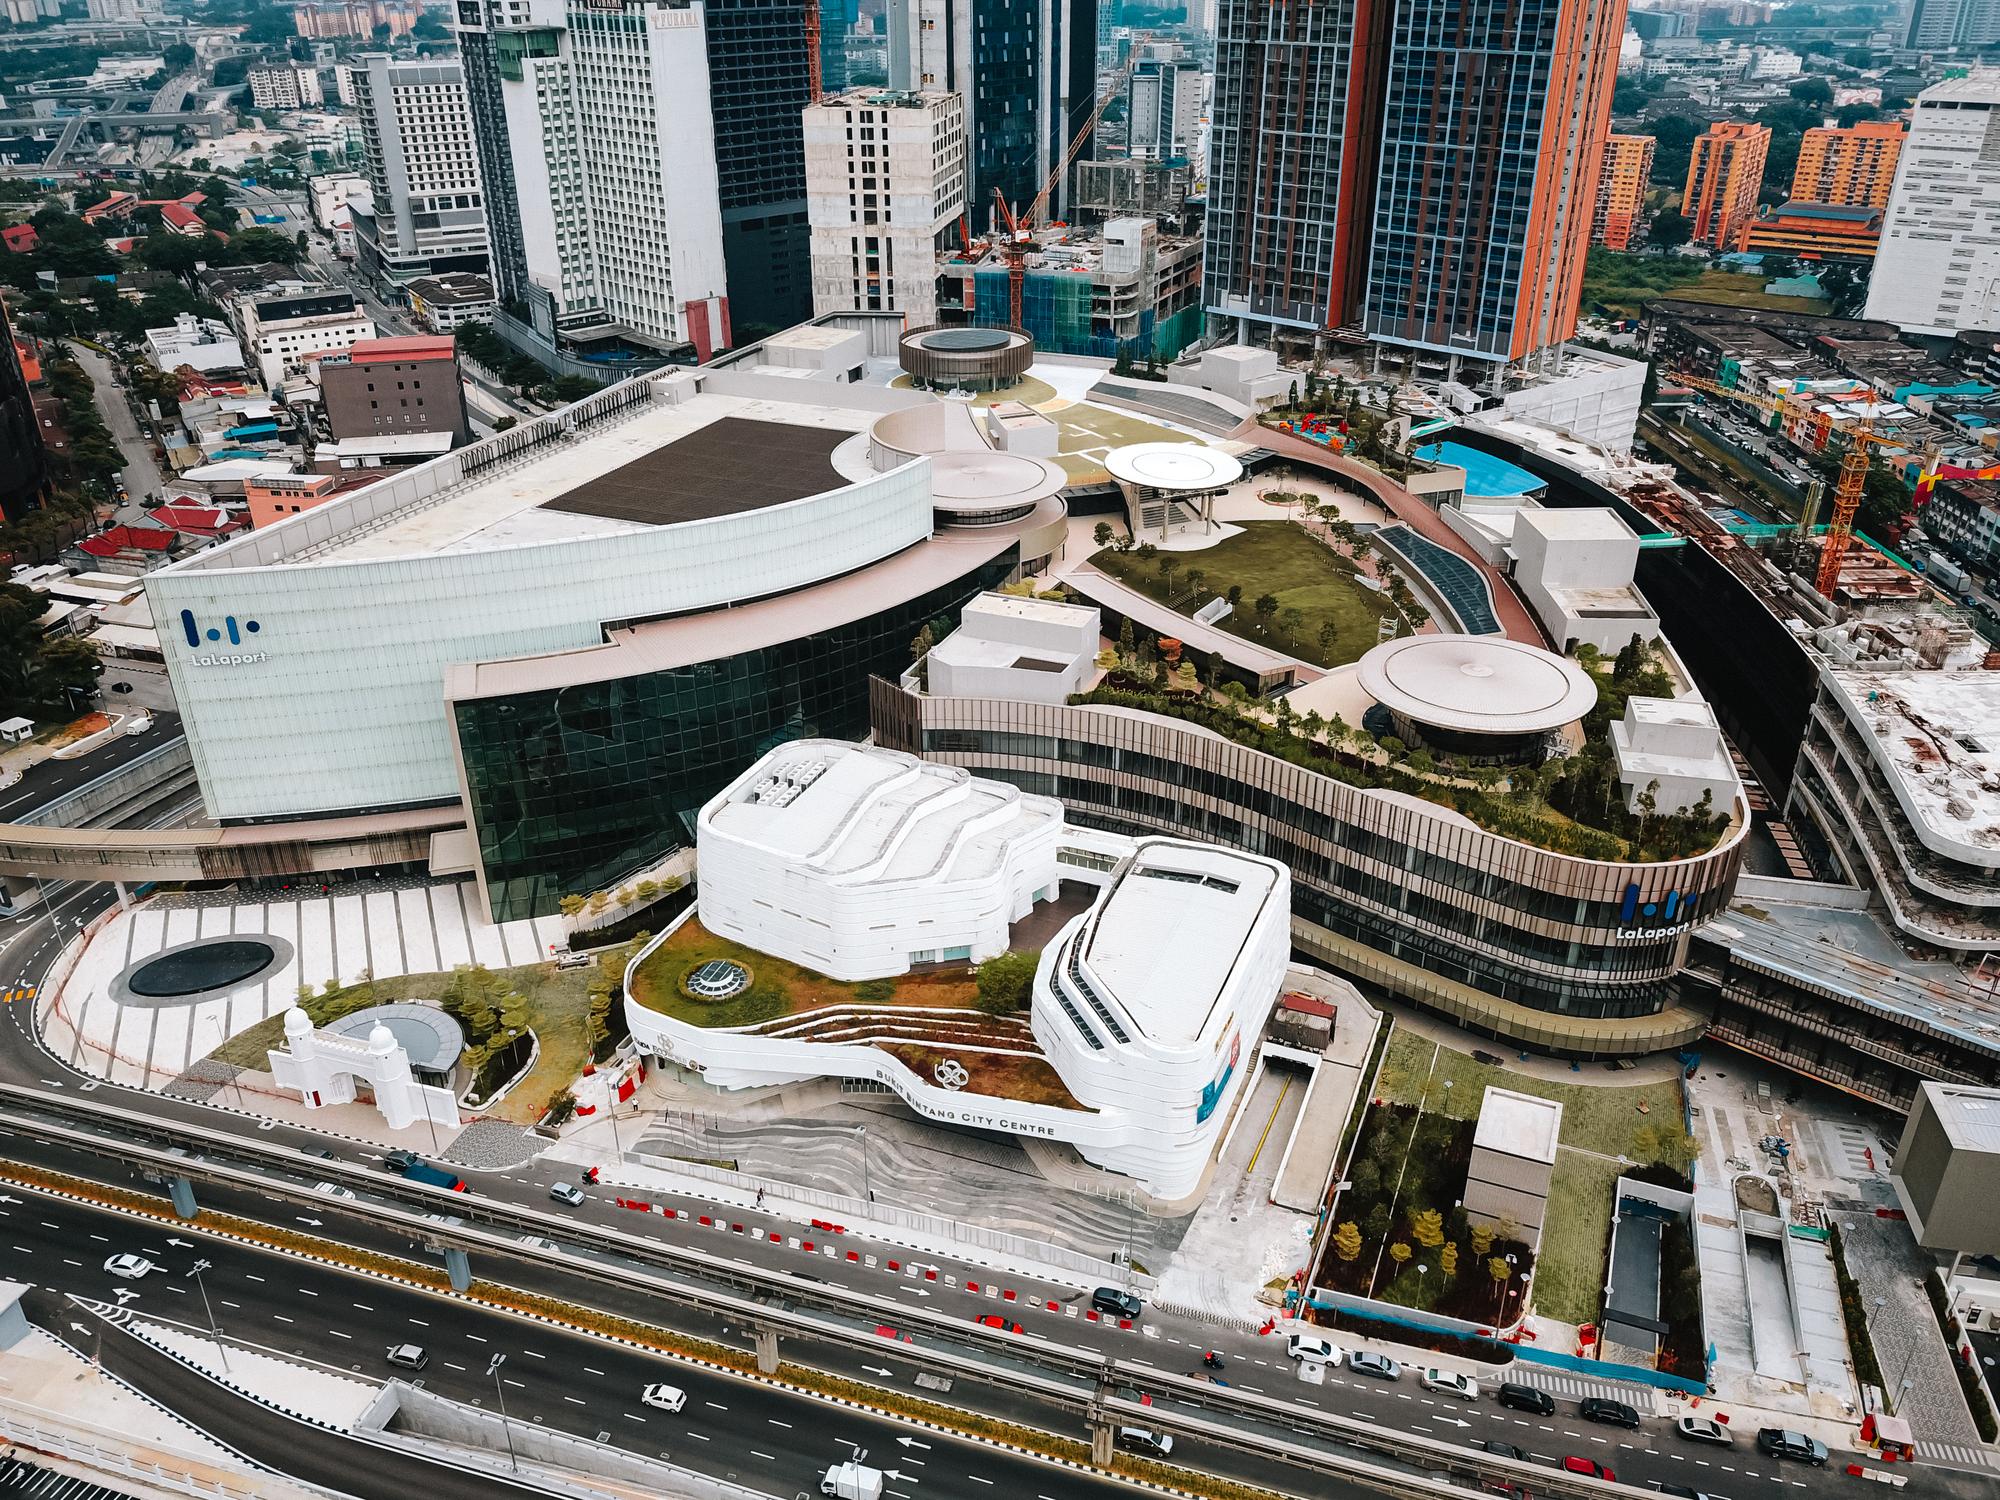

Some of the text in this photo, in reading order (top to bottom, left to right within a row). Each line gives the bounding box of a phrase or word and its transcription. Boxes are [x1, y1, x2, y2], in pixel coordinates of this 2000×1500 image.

[660, 11, 699, 27] FURAMA
[191, 651, 267, 667] LaLaport
[1616, 922, 1690, 940] LaLaport
[876, 1069, 1056, 1136] BUKIT BINTANG CITY CENTRE
